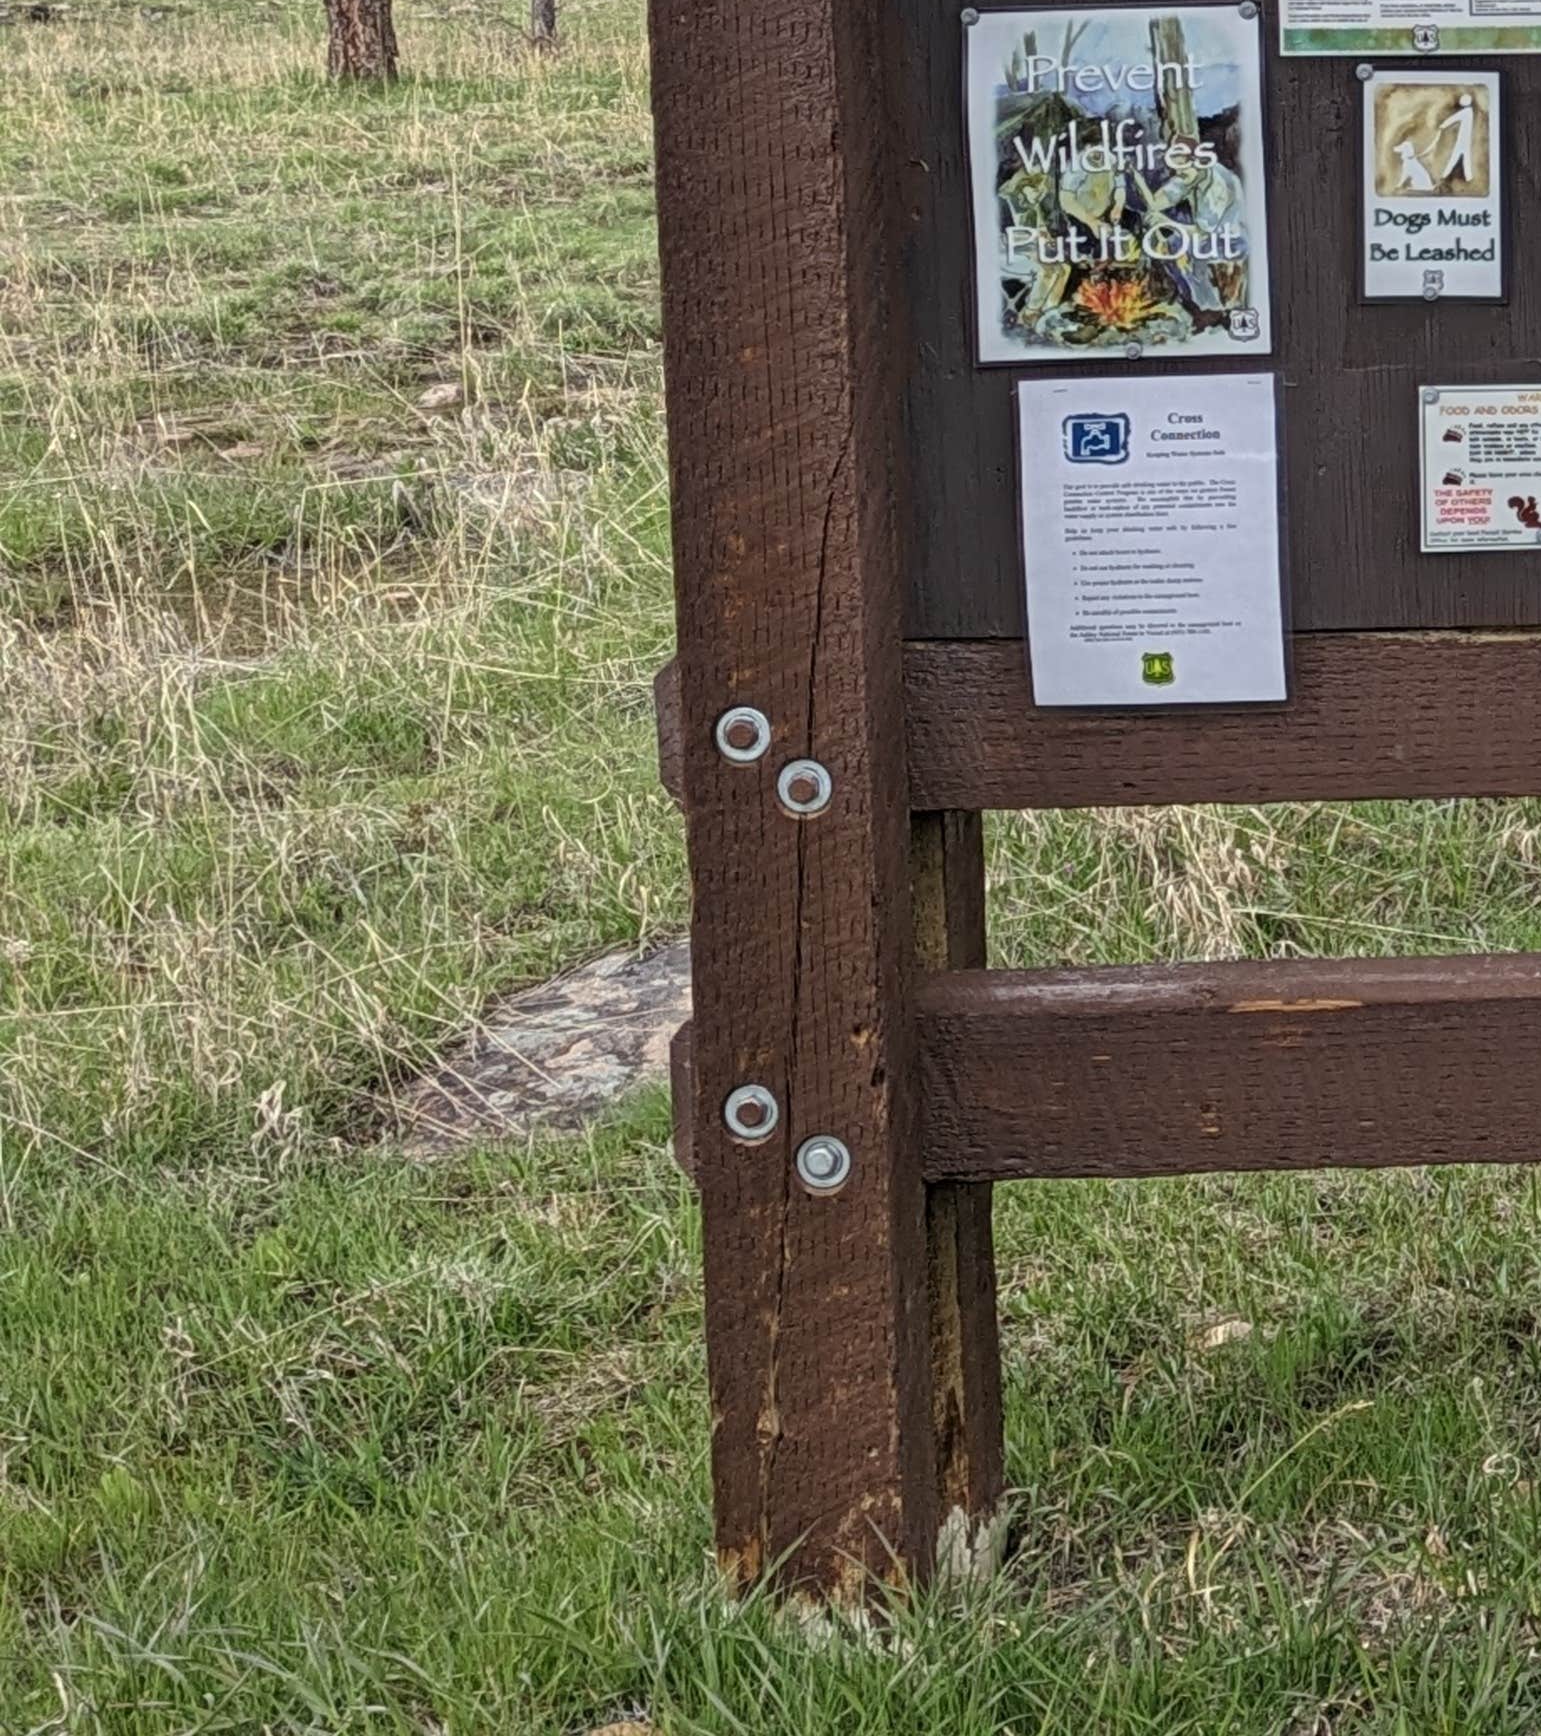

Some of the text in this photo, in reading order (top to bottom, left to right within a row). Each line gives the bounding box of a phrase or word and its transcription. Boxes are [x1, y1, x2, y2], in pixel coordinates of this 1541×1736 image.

[1025, 54, 1205, 94] Prevent
[1013, 118, 1219, 175] Wildfires
[1374, 207, 1492, 235] Dogs Must
[1005, 220, 1242, 264] Put It Out
[1370, 238, 1497, 262] Be Leashed
[1167, 412, 1204, 424] Cross
[1440, 405, 1470, 415] FOOD
[1474, 405, 1498, 415] AND
[1501, 404, 1539, 415] ODORS
[1150, 428, 1221, 441] Connection
